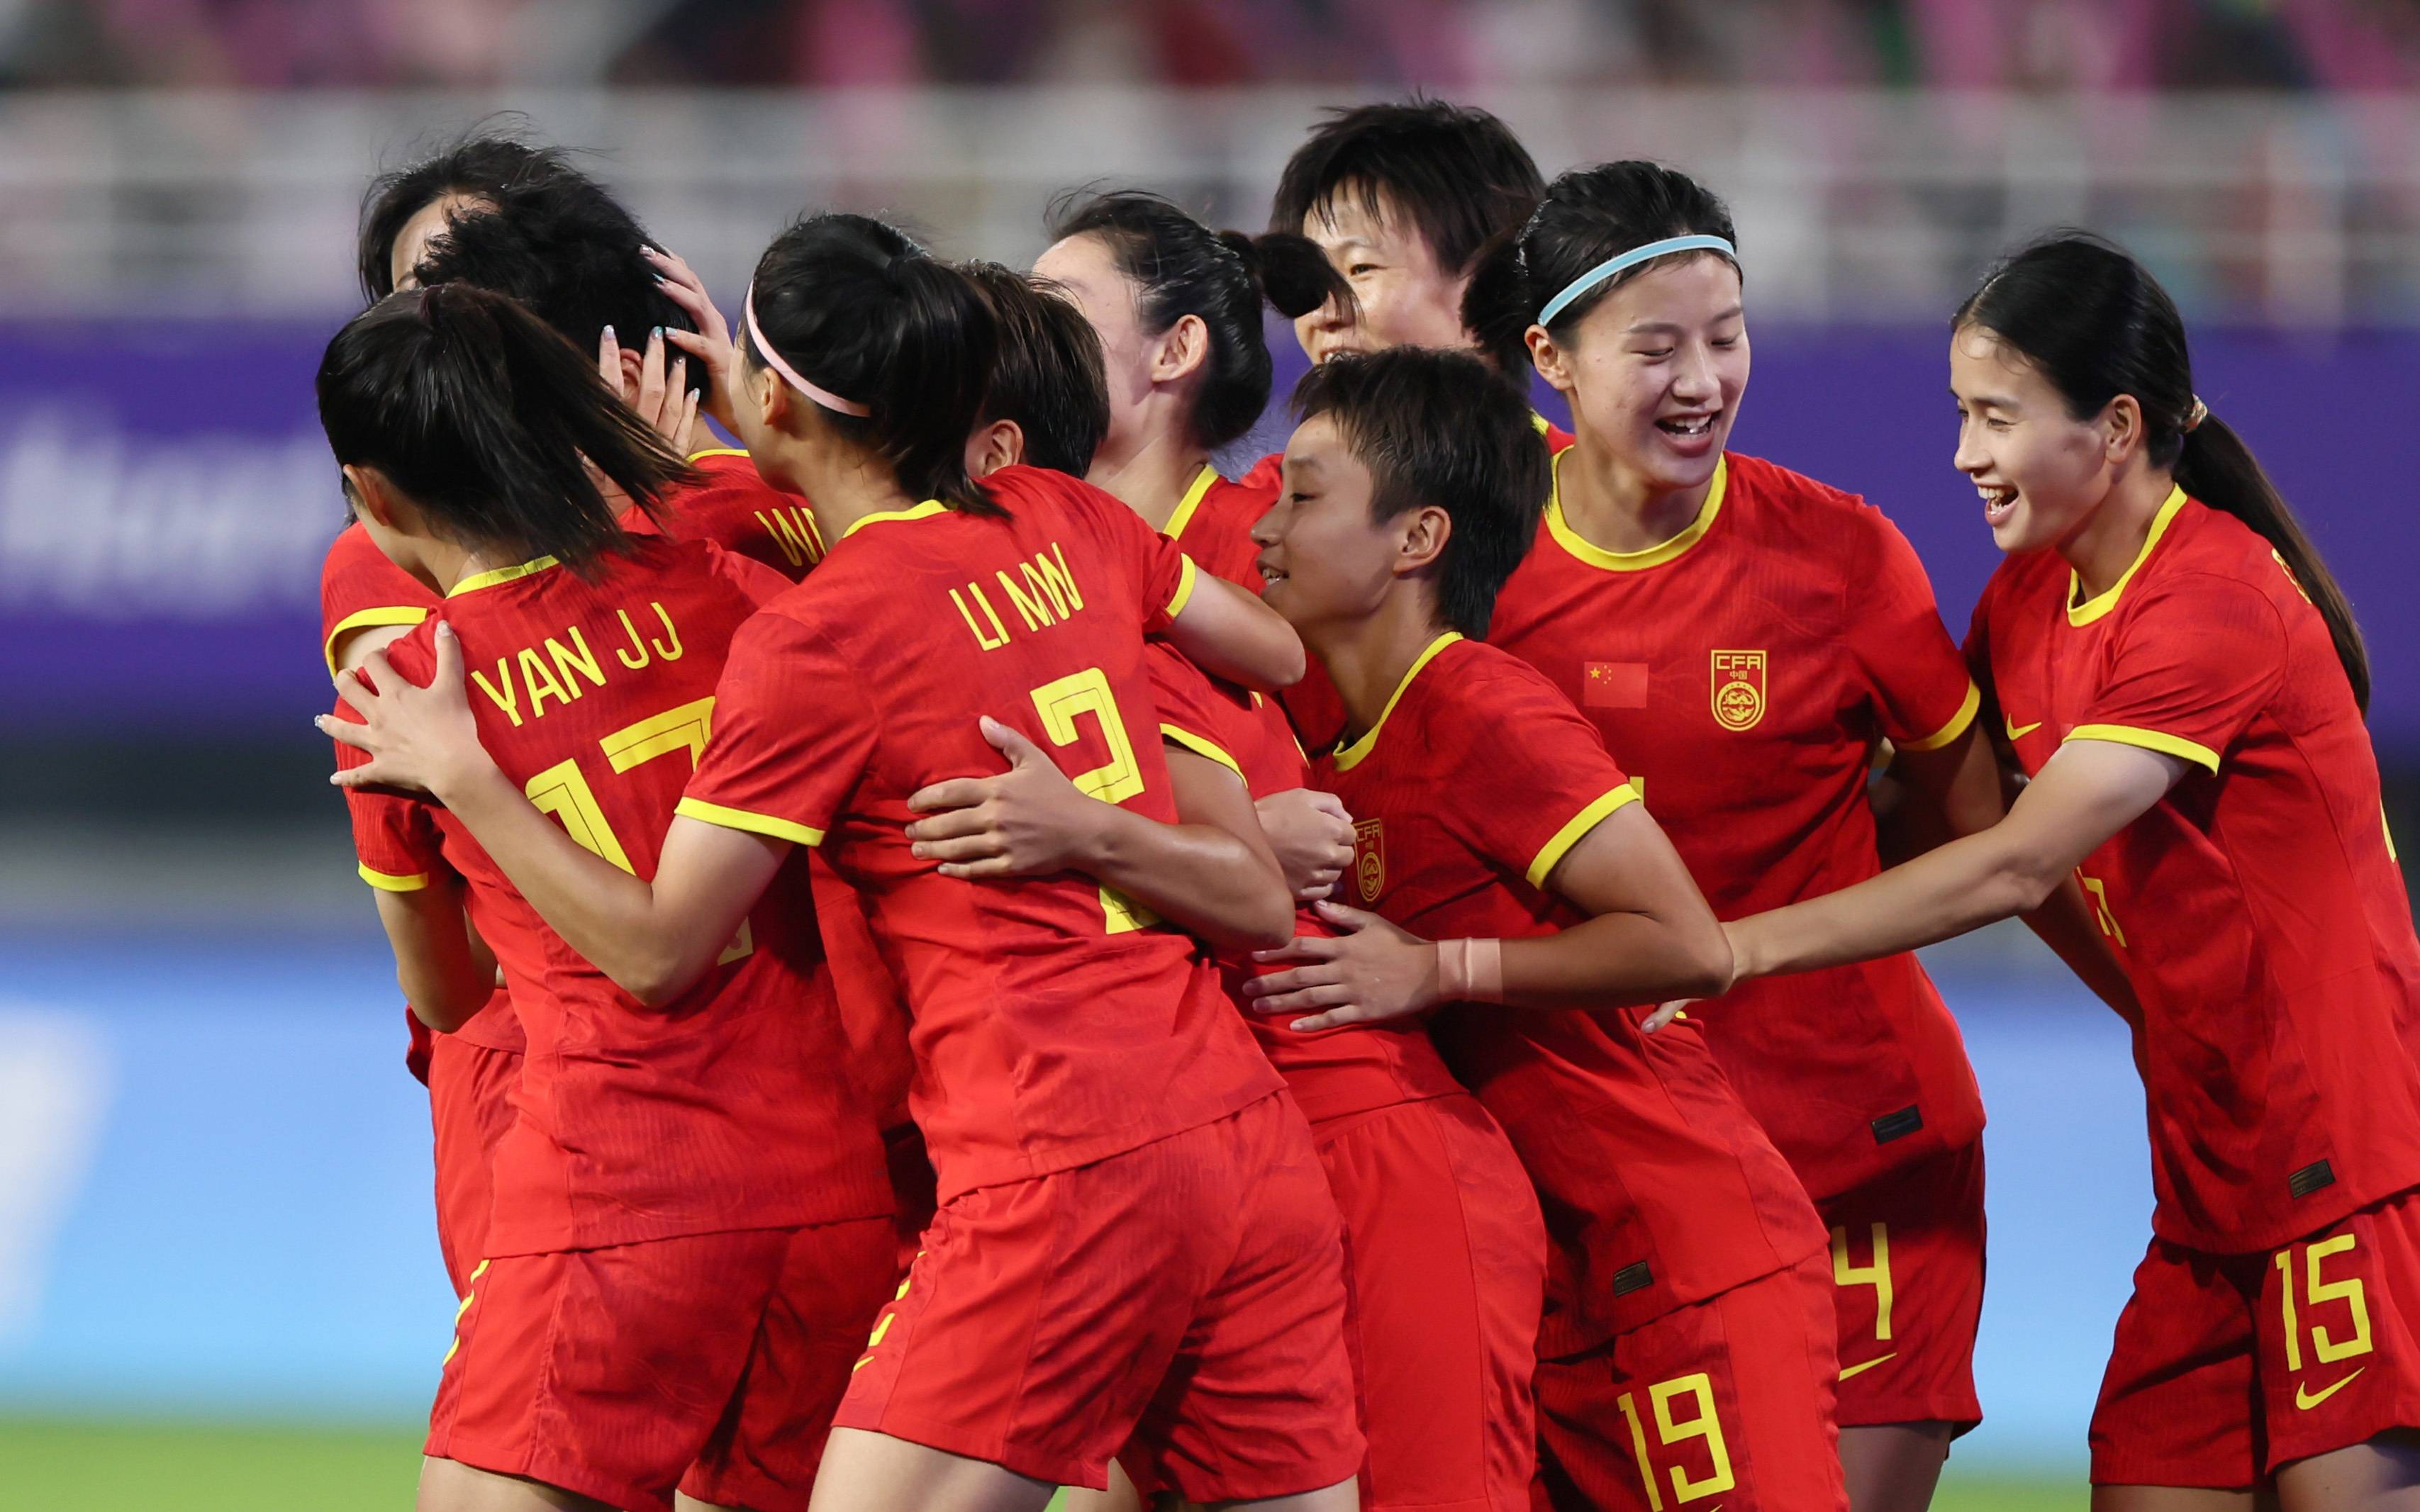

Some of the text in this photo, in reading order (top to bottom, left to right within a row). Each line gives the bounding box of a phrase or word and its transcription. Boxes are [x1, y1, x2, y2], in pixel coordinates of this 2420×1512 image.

[948, 542, 1084, 651] LI MW
[470, 602, 683, 727] YAN JJ
[1717, 656, 1761, 670] CFA
[1030, 667, 1163, 934] 2
[1356, 824, 1380, 843] CFA
[2275, 1233, 2373, 1372] 15
[1617, 1372, 1735, 1512] 19
